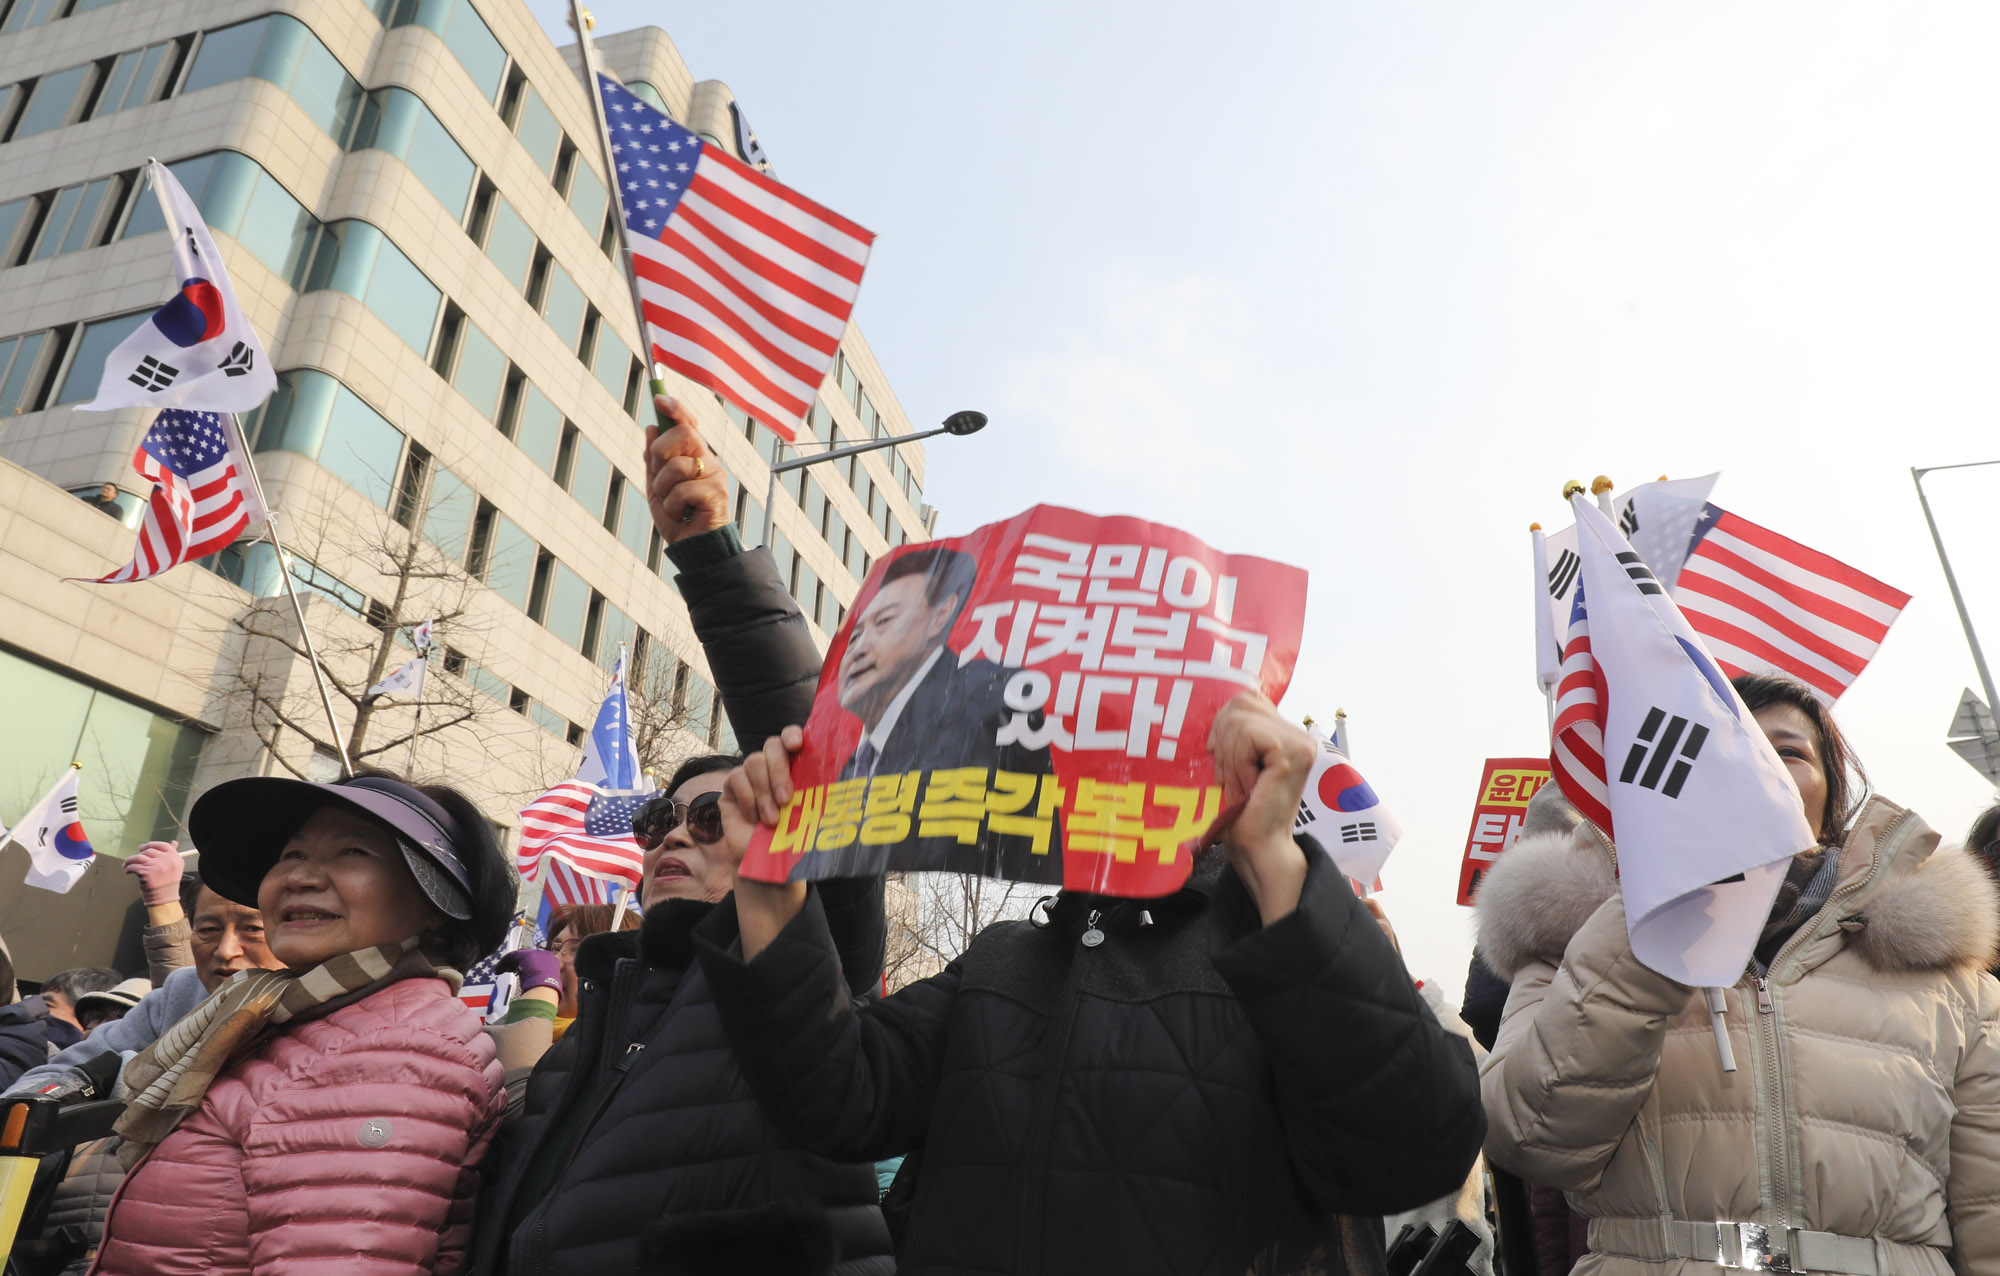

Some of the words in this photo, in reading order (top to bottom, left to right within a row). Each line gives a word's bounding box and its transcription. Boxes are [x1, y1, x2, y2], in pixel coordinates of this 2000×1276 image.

[1012, 533, 1237, 624] 국민이
[957, 599, 1268, 691] 지켜보고
[996, 669, 1194, 761] 있다!
[769, 770, 922, 854] 대통령
[918, 766, 1066, 856] 즉각
[1066, 777, 1222, 865] 복귀
